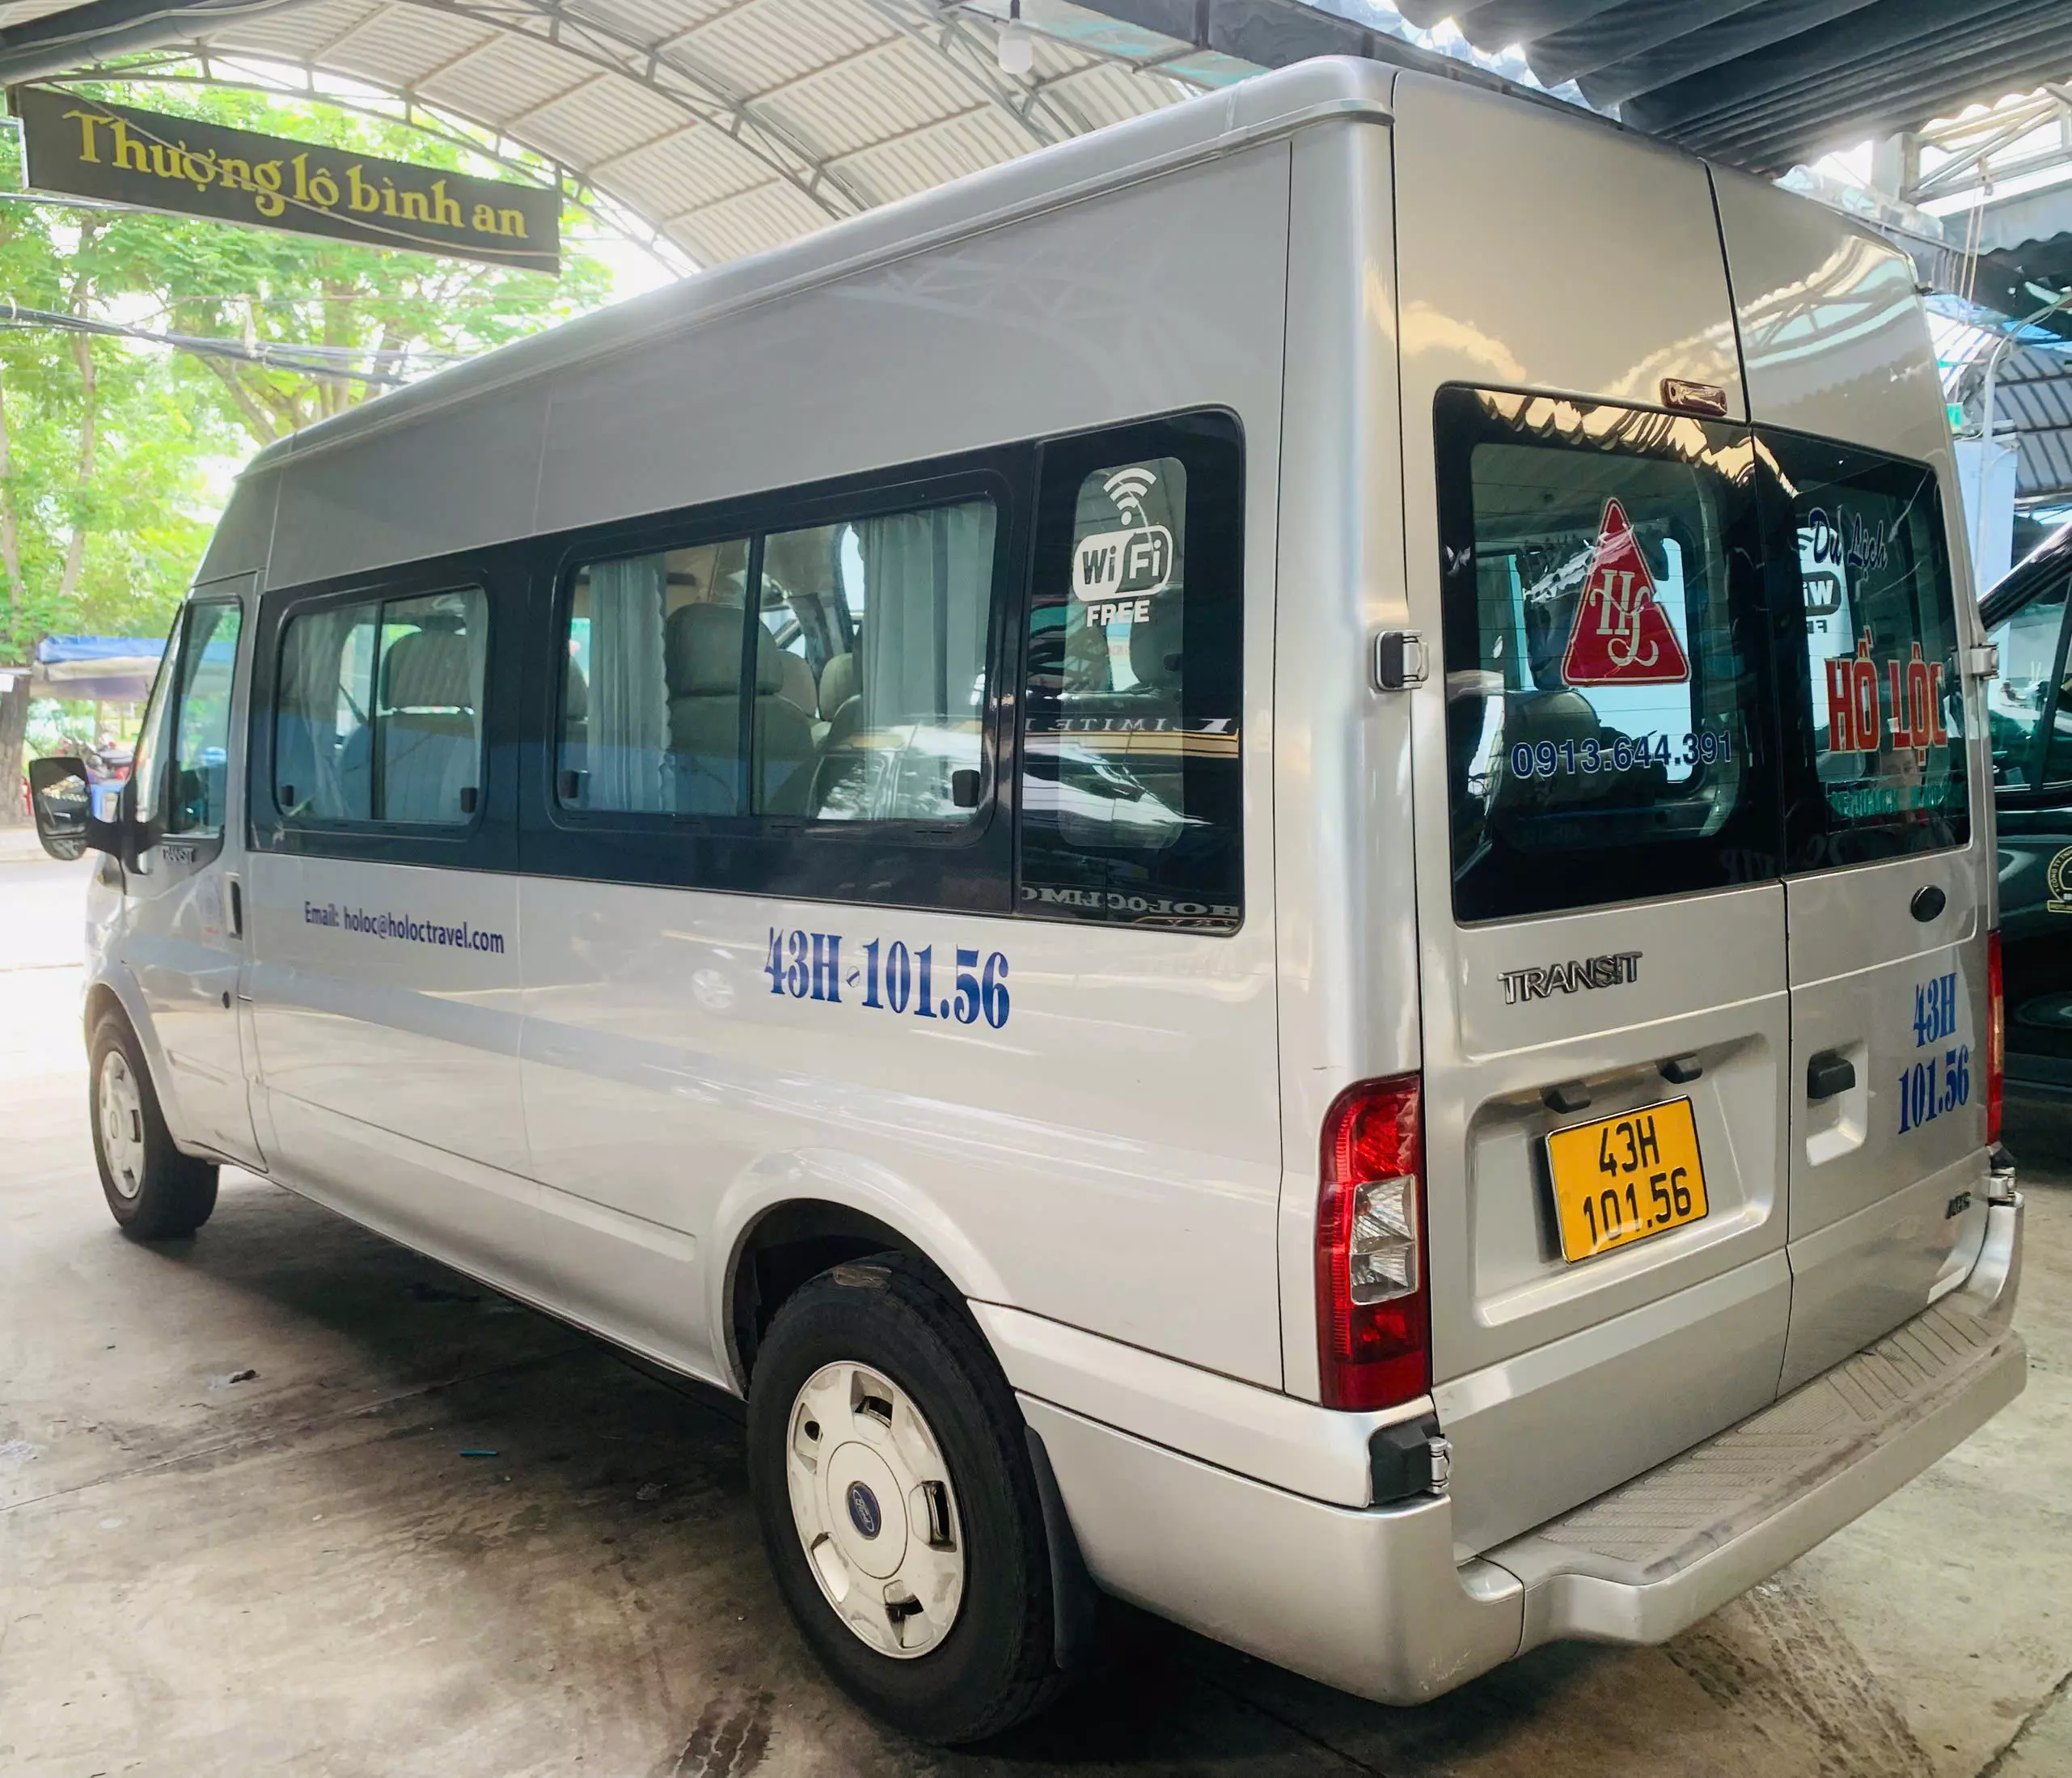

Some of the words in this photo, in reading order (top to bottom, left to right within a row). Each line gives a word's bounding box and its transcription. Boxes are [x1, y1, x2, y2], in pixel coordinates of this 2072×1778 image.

[61, 109, 285, 217] Thượng
[346, 163, 466, 228] bình
[472, 203, 529, 239] an
[1086, 599, 1150, 628] FREE
[1888, 641, 1948, 766] LỘC
[1511, 730, 1732, 780] 0913.644.391
[304, 900, 340, 928] Email:
[344, 905, 505, 954] holoc@holoctravel.com
[1496, 950, 1643, 1005] TRANSIT
[1913, 972, 1957, 1048] 43H
[1898, 1044, 1970, 1134] 101.56
[1599, 1115, 1660, 1178] 43H
[1583, 1166, 1692, 1247] 101.56
